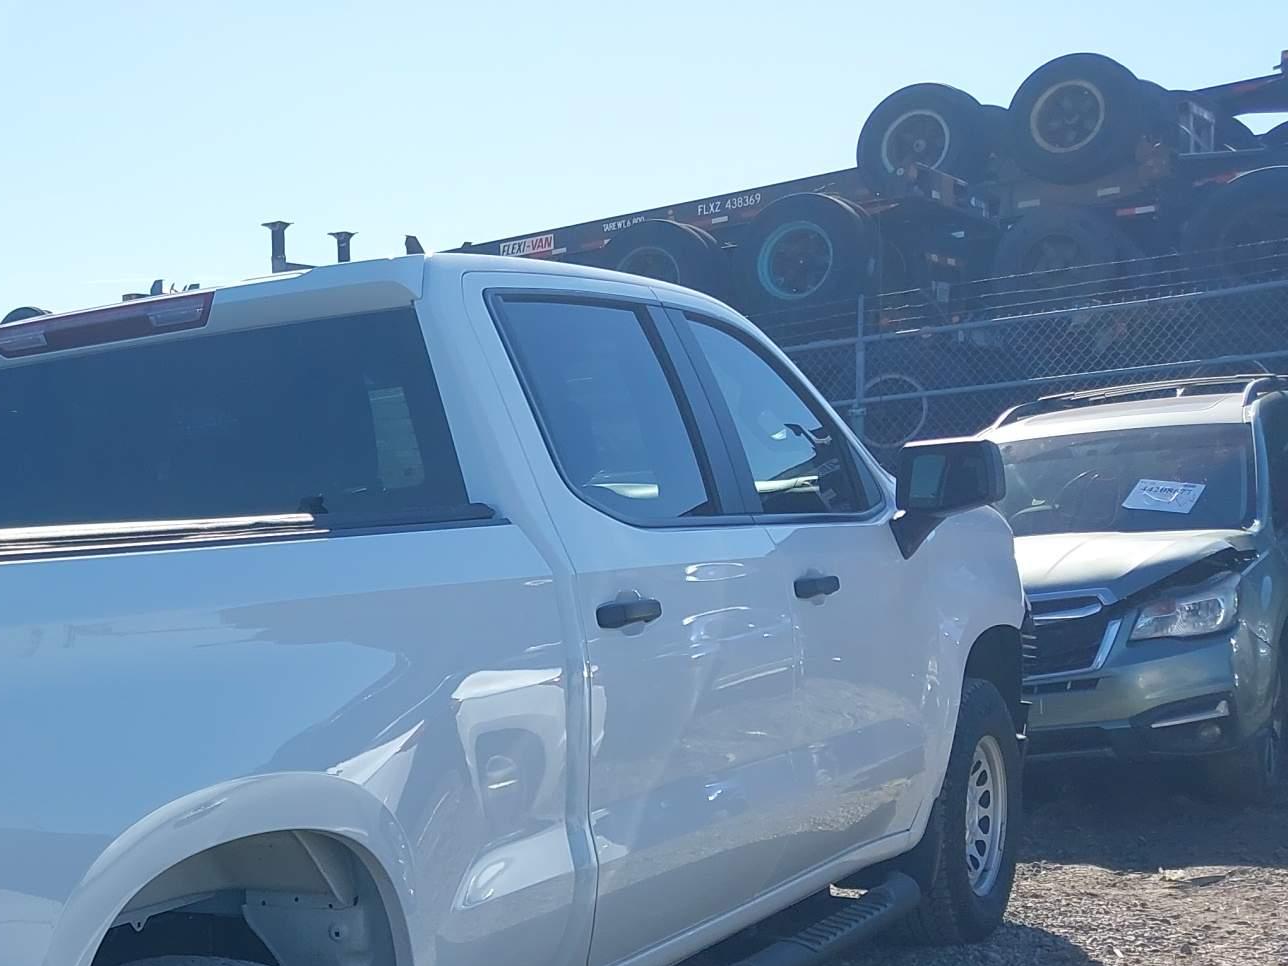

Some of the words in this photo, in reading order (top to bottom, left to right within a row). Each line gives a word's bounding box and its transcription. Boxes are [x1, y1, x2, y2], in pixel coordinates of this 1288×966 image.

[697, 201, 721, 216] FLXZ
[725, 193, 761, 210] 438369
[501, 236, 554, 257] FLEXI-VAN
